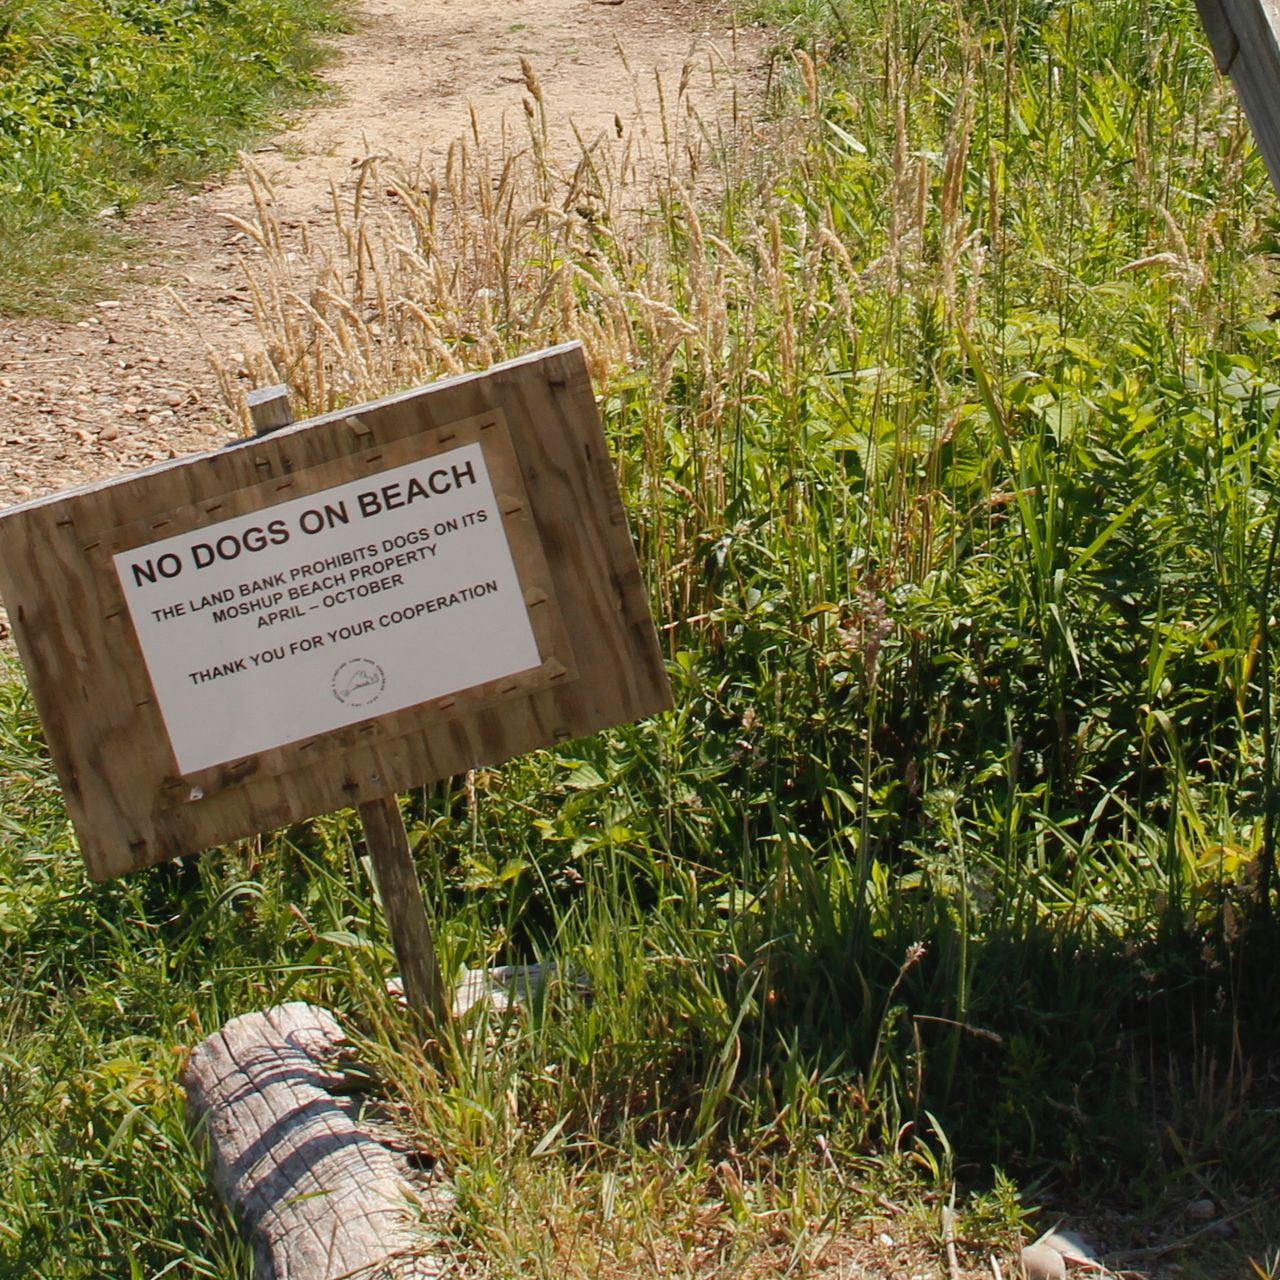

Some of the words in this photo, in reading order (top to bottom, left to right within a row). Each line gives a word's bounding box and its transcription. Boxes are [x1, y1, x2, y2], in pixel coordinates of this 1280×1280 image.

[131, 552, 183, 588] NO
[190, 519, 290, 570] DOGS
[299, 500, 350, 535] ON
[356, 460, 477, 519] BEACH
[151, 602, 187, 623] THE
[188, 588, 235, 613] LAND
[238, 572, 287, 597] BANK
[289, 544, 379, 582] PROHIBITS
[381, 528, 430, 553] DOGS
[433, 518, 459, 536] ON
[461, 509, 488, 528] ITS
[188, 658, 248, 685] THANK
[249, 646, 286, 667] YOU
[289, 635, 325, 656] FOR
[327, 619, 376, 643] YOUR
[378, 579, 498, 628] COOPERATION
[212, 592, 284, 624] MOSHUP
[287, 572, 347, 601] BEACH
[349, 543, 439, 582] PROPERTY
[256, 605, 306, 629] APRIL
[322, 573, 404, 608] OCTOBER
